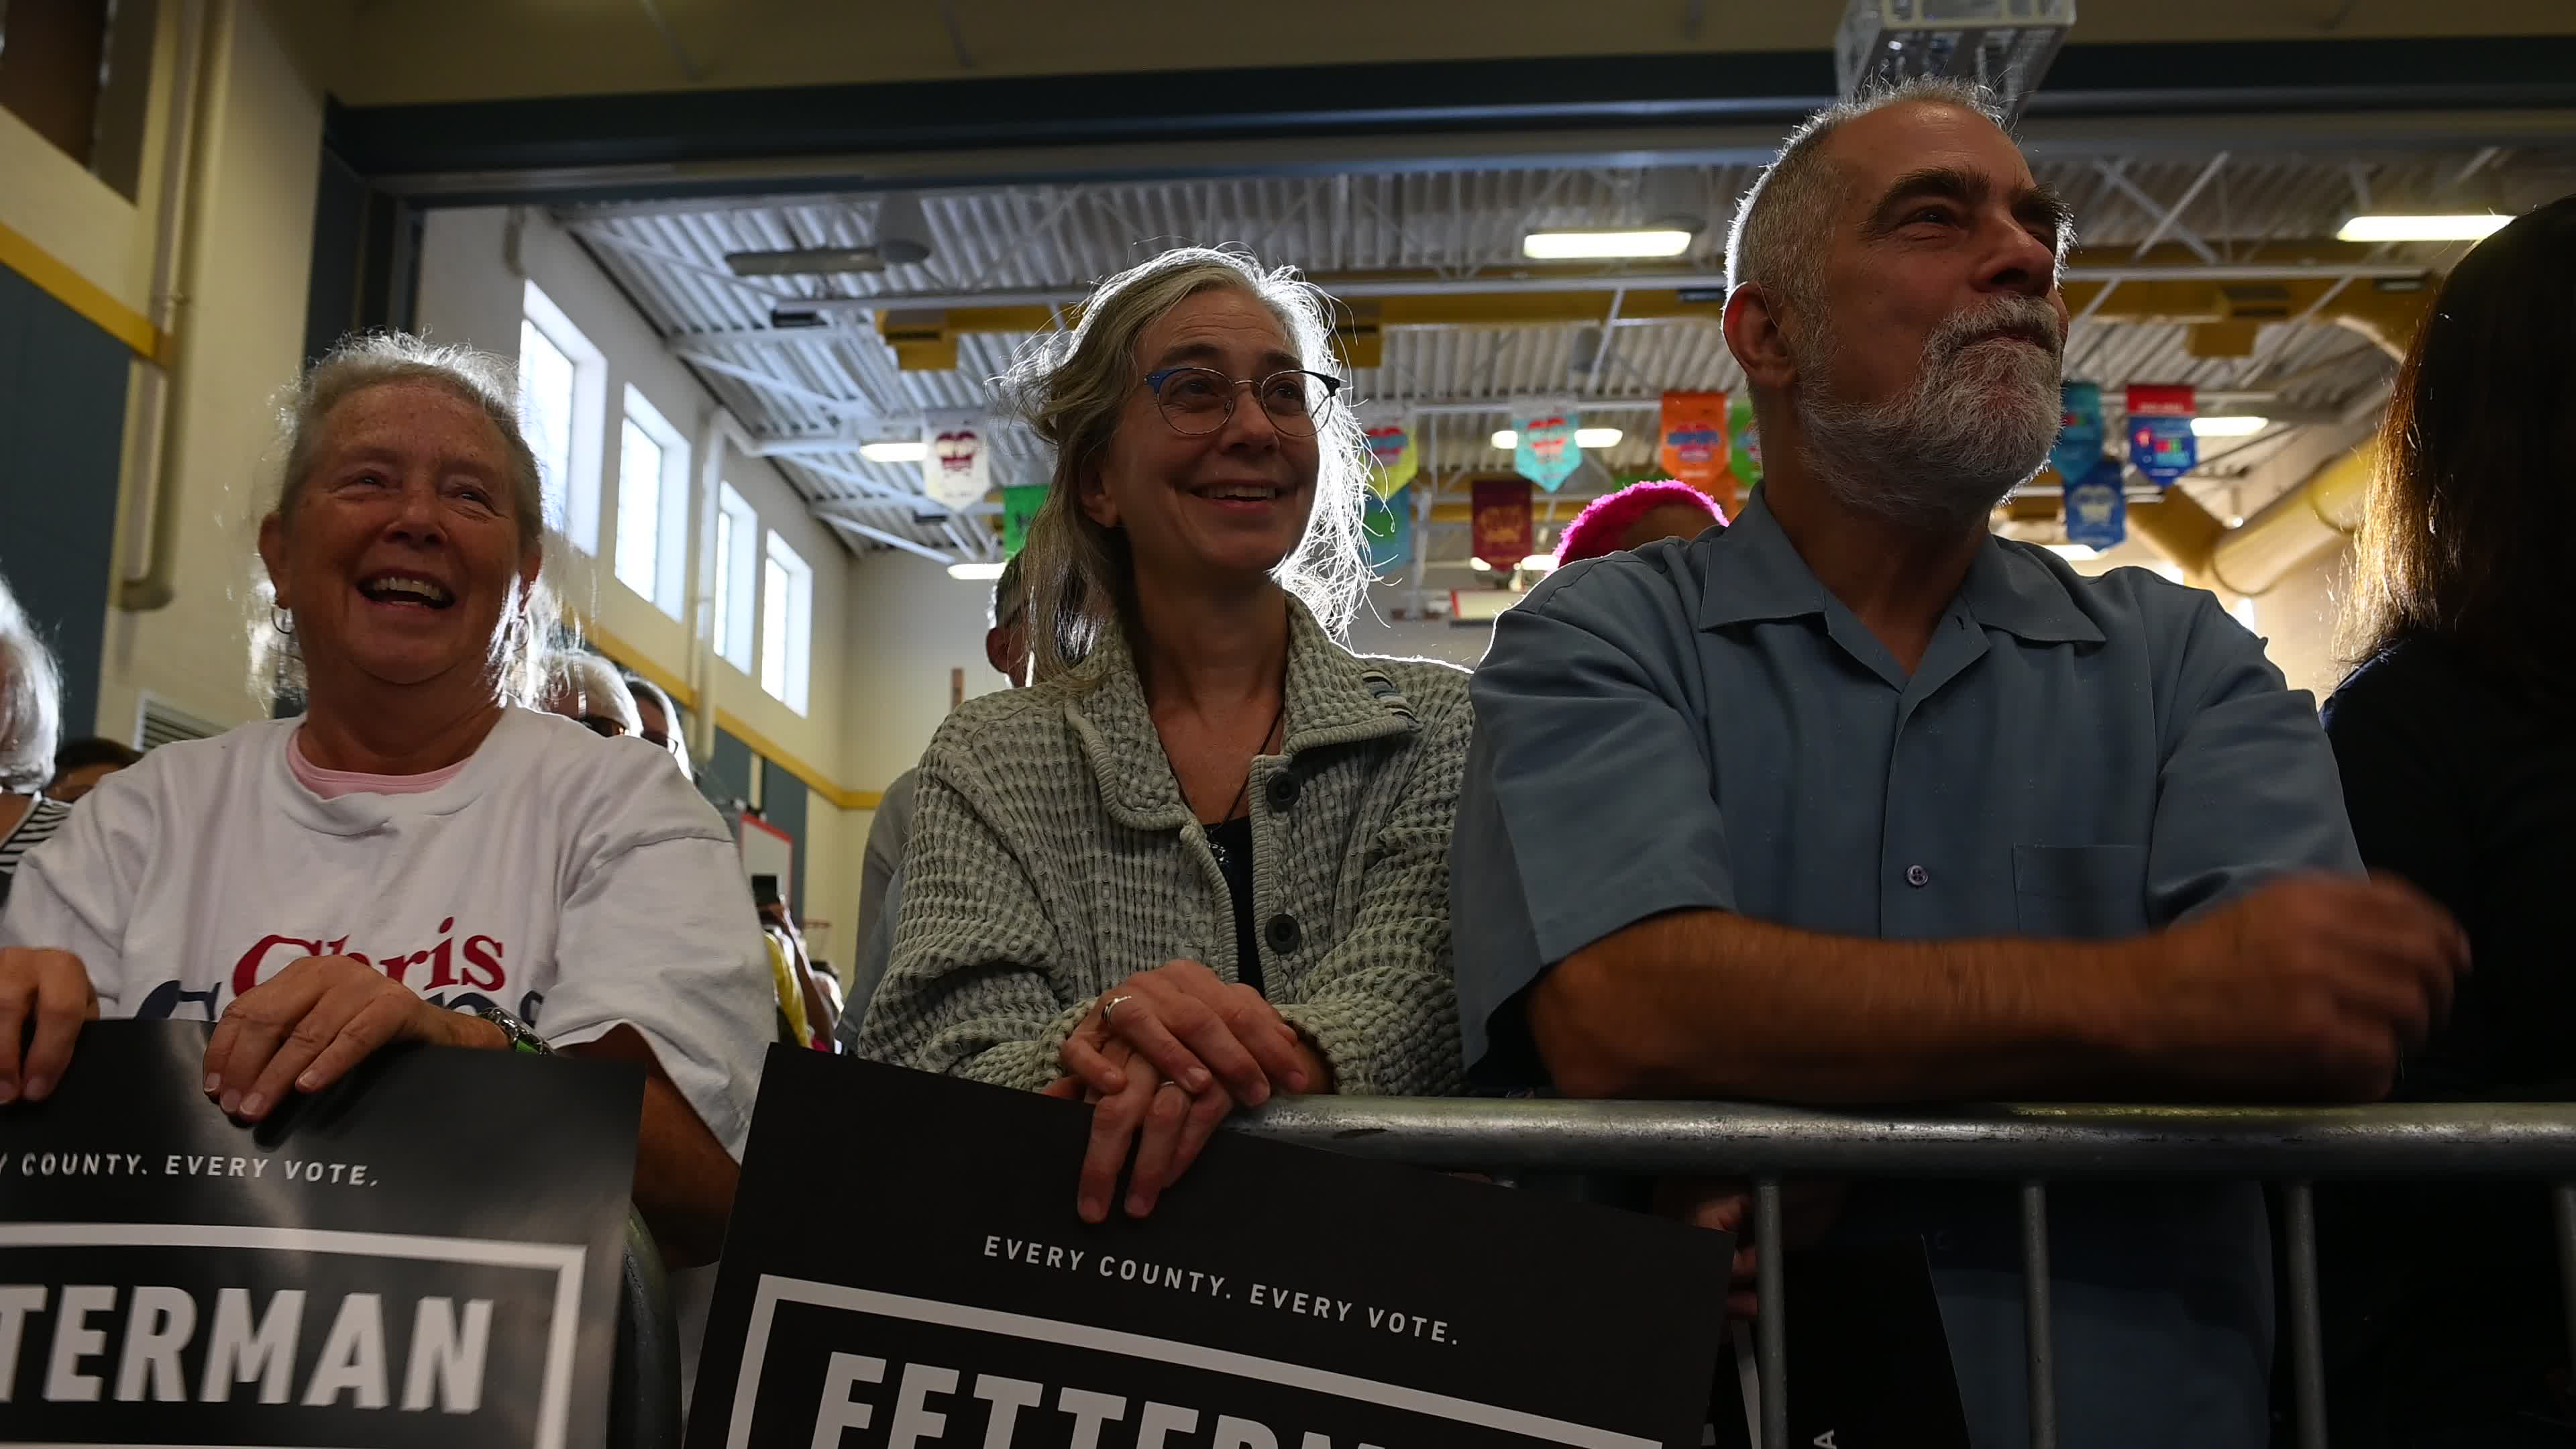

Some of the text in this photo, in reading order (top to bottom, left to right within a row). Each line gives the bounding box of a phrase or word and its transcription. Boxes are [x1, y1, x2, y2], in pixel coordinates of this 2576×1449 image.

[21, 1152, 149, 1177] COUNTY.
[164, 1154, 270, 1179] EVERY
[284, 1159, 380, 1187] VOTE.
[983, 1234, 1459, 1346] EVERY COUNTY. EVERY VOTE.
[0, 1283, 495, 1415] TERMAN
